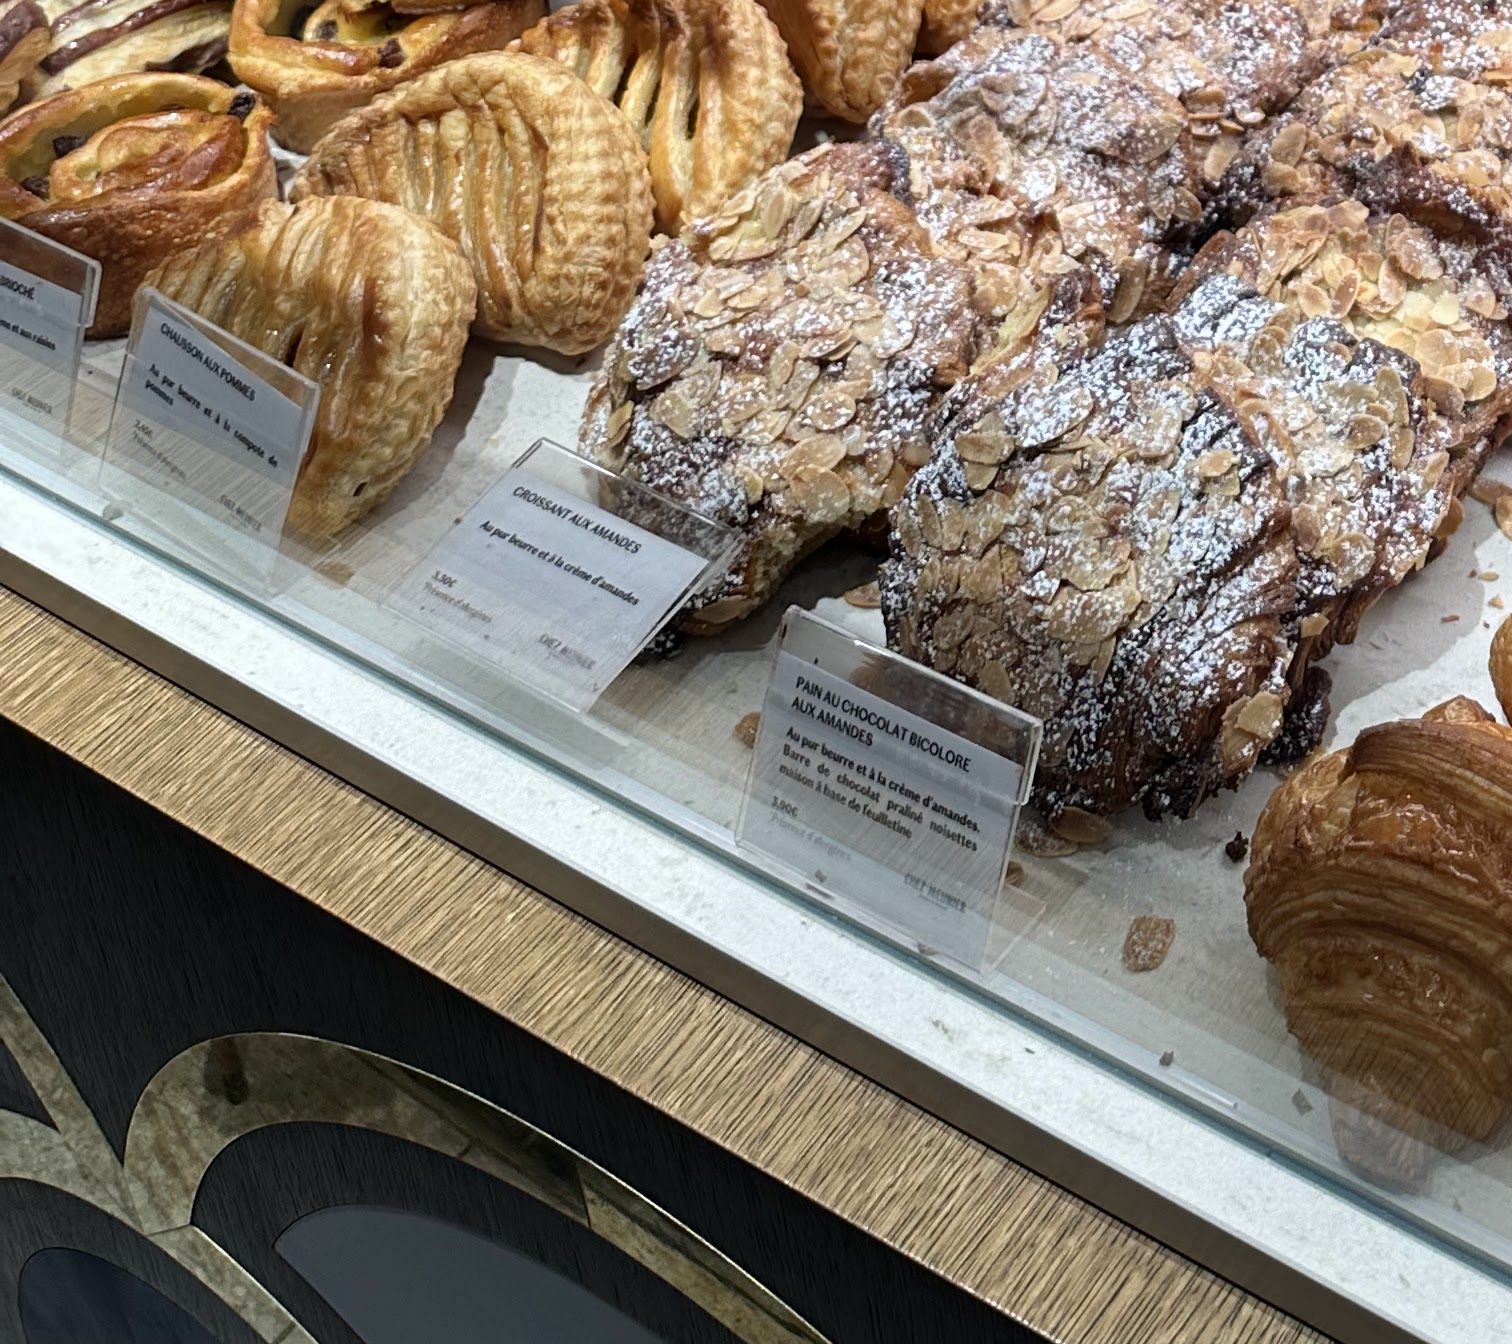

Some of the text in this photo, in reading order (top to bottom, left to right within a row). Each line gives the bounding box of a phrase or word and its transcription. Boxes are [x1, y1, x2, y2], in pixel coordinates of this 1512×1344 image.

[160, 322, 256, 402] CHAUSSON AUX POMMES
[479, 519, 493, 532] Au
[489, 525, 511, 541] pur
[507, 531, 540, 556] beurre
[537, 548, 550, 563] et
[554, 555, 566, 570] la
[563, 559, 593, 584] crème
[512, 485, 642, 555] CROISSANT AUX AMANDES
[791, 695, 875, 747] AUX AMANDES
[795, 675, 972, 773] PAIN AU CHOCOLAT BICOLORE
[779, 763, 815, 790] maison
[822, 781, 847, 806] base
[847, 796, 861, 812] de
[782, 743, 978, 853] Barre de chocolat praliné noisettes
[786, 726, 801, 743] Au
[800, 735, 820, 752] pur
[820, 741, 856, 771] beurre
[855, 763, 869, 778] et
[867, 766, 876, 782] à
[876, 770, 888, 787] la
[888, 777, 921, 803] crème
